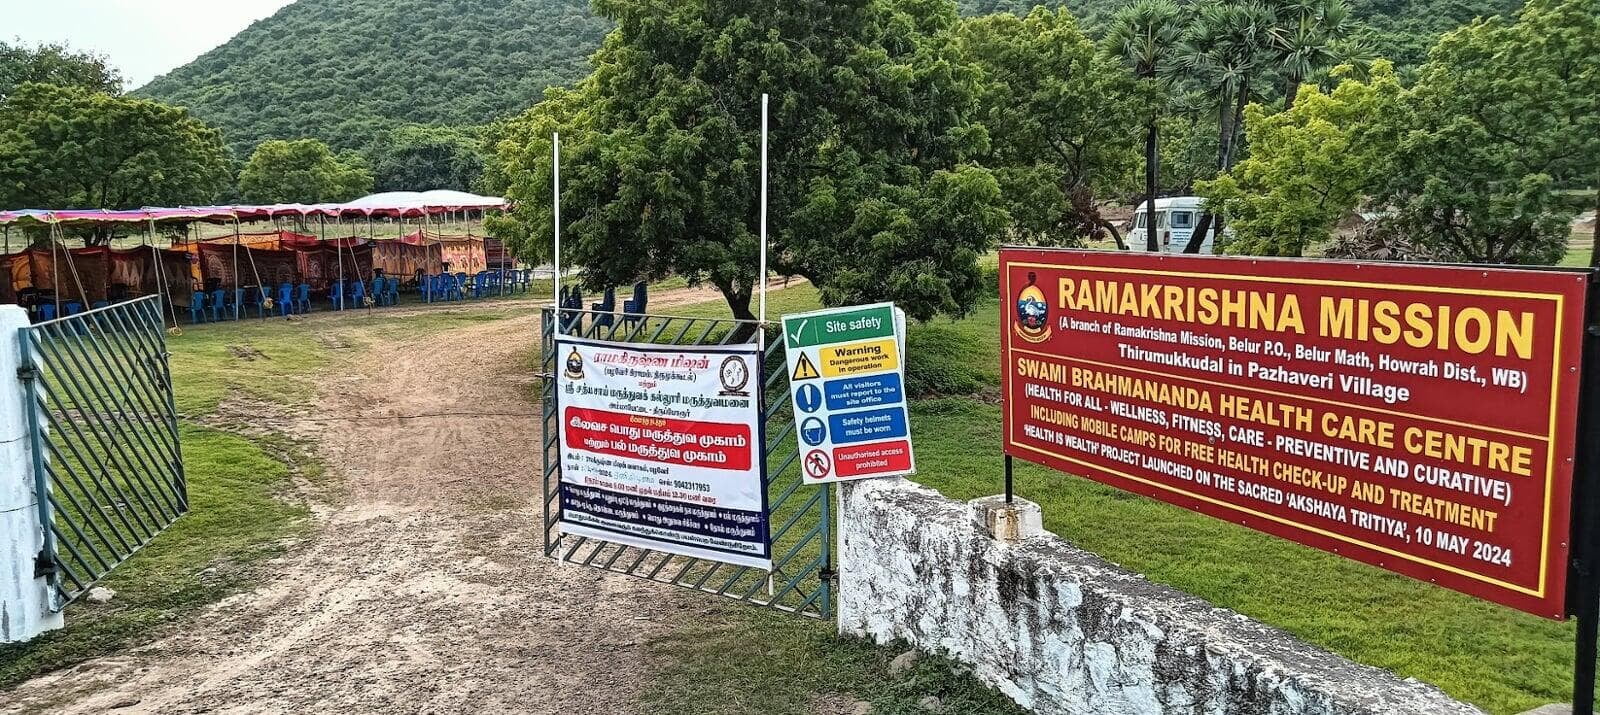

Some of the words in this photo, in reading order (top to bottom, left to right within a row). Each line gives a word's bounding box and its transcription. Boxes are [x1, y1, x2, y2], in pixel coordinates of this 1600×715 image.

[825, 319, 846, 332] Site
[848, 314, 882, 332] safety
[1058, 277, 1305, 334] RAMAKRISHNA
[1319, 296, 1534, 359] MISSION
[834, 343, 881, 358] Warning
[1058, 316, 1069, 330] (A
[1070, 317, 1100, 332] branch
[1102, 321, 1112, 334] of
[1113, 322, 1177, 343] Ramakrishna
[1180, 330, 1225, 352] Mission,
[1228, 336, 1261, 353] Belur
[1264, 340, 1291, 361] P.O.,
[1295, 343, 1331, 362] Belur
[1334, 348, 1374, 372] Math,
[1378, 353, 1438, 377] Howrah
[1443, 361, 1486, 387] Dist.,
[1491, 367, 1527, 393] WB)
[671, 352, 710, 373] மிஷன்
[829, 355, 869, 366] Dangerous
[846, 362, 882, 372] operation
[1117, 342, 1223, 373] Thirumukkudal
[1228, 358, 1242, 376] in
[1248, 361, 1333, 390] Pazhaveri
[1339, 374, 1410, 403] Village
[854, 380, 881, 388] visitors
[682, 392, 749, 411] மருத்துவமனை
[850, 389, 873, 398] report
[842, 416, 862, 426] Safety
[864, 413, 891, 423] helmets
[1017, 357, 1066, 384] SWAMI
[1071, 366, 1213, 413] BRAHMANANDA
[1219, 393, 1312, 432] HEALTH
[1321, 412, 1394, 449] CARE
[1404, 426, 1532, 476] CENTRE
[569, 415, 607, 431] இலவச
[609, 422, 640, 438] பொது
[642, 425, 696, 446] மருத்துவ
[699, 429, 746, 451] முகாம்
[845, 427, 862, 436] must
[873, 424, 891, 432] worn
[584, 436, 608, 449] மற்றும்
[610, 438, 625, 451] பல்
[628, 440, 680, 461] மருத்துவ
[682, 446, 726, 466] முகாம்
[1024, 382, 1062, 402] (HEALTH
[1063, 390, 1082, 407] FOR
[1084, 395, 1102, 411] ALL
[1109, 400, 1169, 429] WELLNESS,
[1172, 413, 1225, 442] FITNESS,
[1228, 425, 1264, 447] CARE
[1275, 434, 1370, 470] PREVENTIVE
[1373, 455, 1409, 478] AND
[1413, 463, 1511, 506] CURATIVE)
[838, 449, 880, 460] Unauthorised
[855, 459, 888, 469] prohibited
[1030, 404, 1078, 429] INCLUDING
[1080, 416, 1117, 439] MOBILE
[1119, 425, 1156, 448] CAMPS
[1159, 434, 1181, 455] FOR
[1184, 440, 1214, 463] FREE
[1217, 448, 1268, 476] HEALTH
[1273, 461, 1347, 495] CHECK-UP
[1350, 480, 1384, 504] AND
[1389, 488, 1497, 532] TREATMENT
[674, 479, 710, 493] 9042317953
[1055, 431, 1063, 445] IS
[1100, 443, 1140, 466] PROJECT
[1142, 454, 1193, 480] LAUNCHED
[1195, 468, 1210, 486] ON
[1212, 472, 1235, 492] THE
[1237, 479, 1283, 504] SACRED
[1415, 525, 1432, 545] 10
[1436, 530, 1469, 554] MAY
[1472, 540, 1511, 567] 2024
